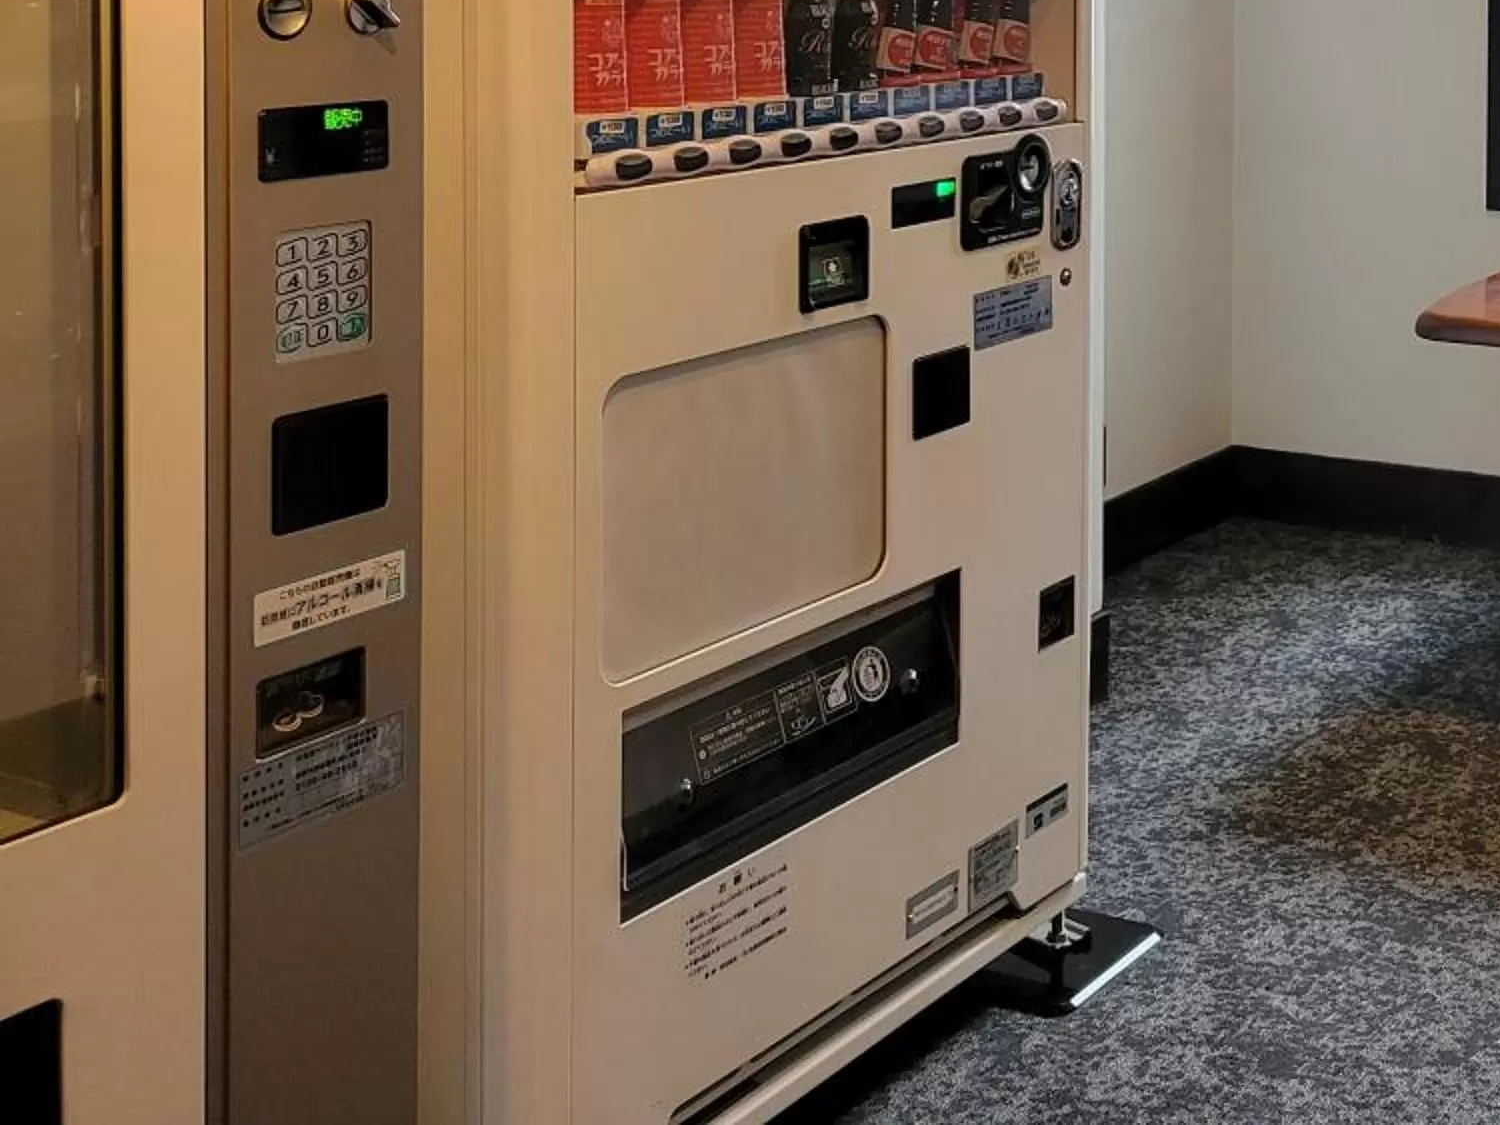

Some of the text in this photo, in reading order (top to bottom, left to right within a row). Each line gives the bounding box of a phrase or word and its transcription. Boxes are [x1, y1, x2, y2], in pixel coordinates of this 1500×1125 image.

[287, 236, 359, 259] 1 2 3
[287, 265, 359, 287] 4 5 6
[287, 291, 359, 317] 7 8 9
[317, 324, 329, 340] 0
